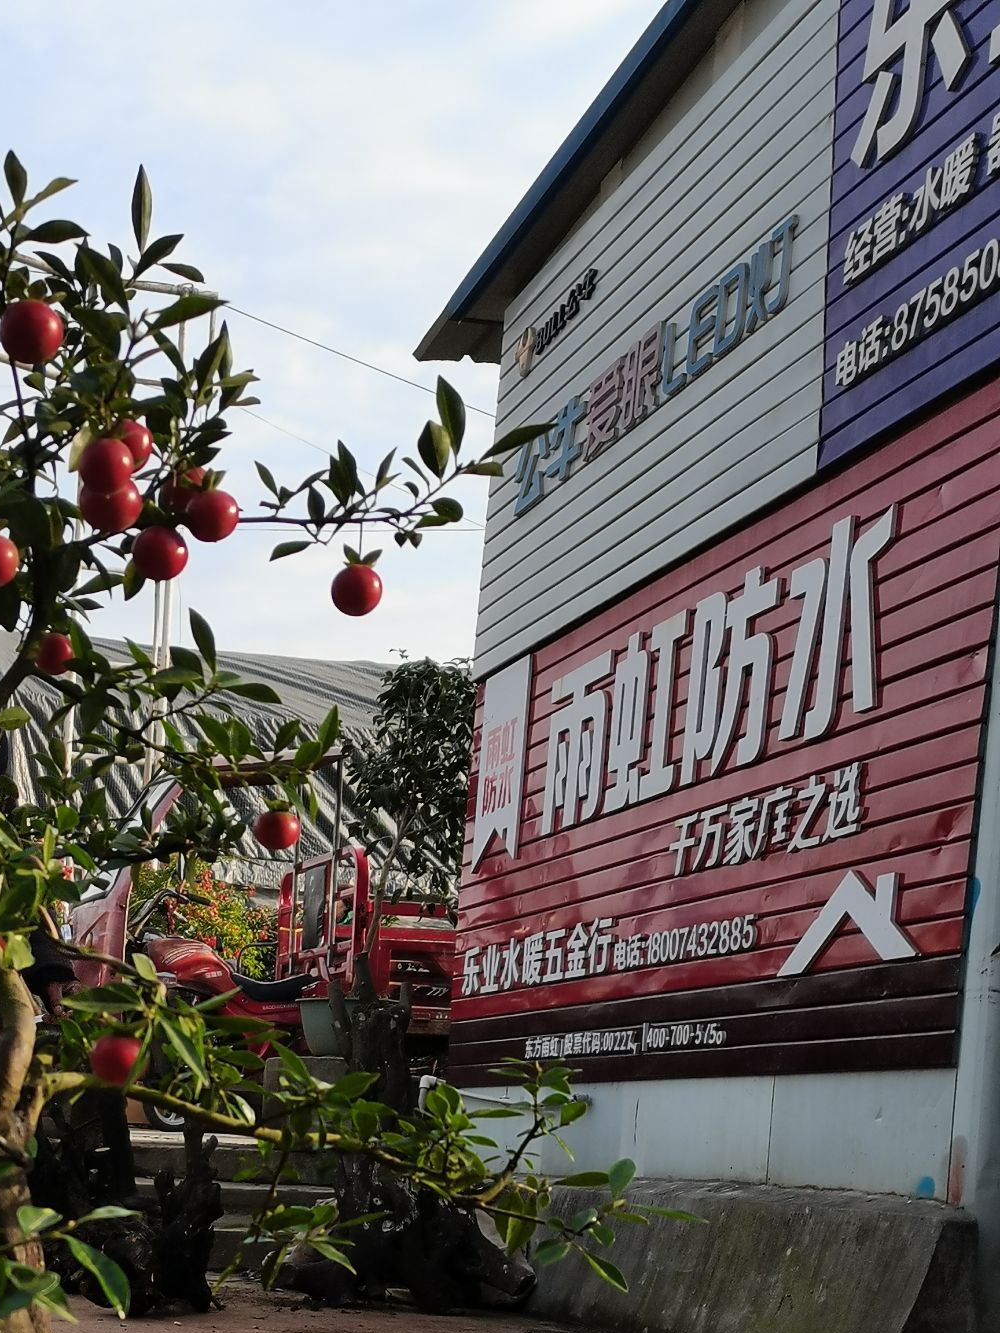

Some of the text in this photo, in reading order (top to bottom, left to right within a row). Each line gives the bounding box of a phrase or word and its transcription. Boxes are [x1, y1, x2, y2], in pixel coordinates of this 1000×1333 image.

[835, 238, 1000, 387] 电话:875850
[540, 503, 899, 836] 雨虹防水
[461, 917, 615, 995] 乐业水暖五金行
